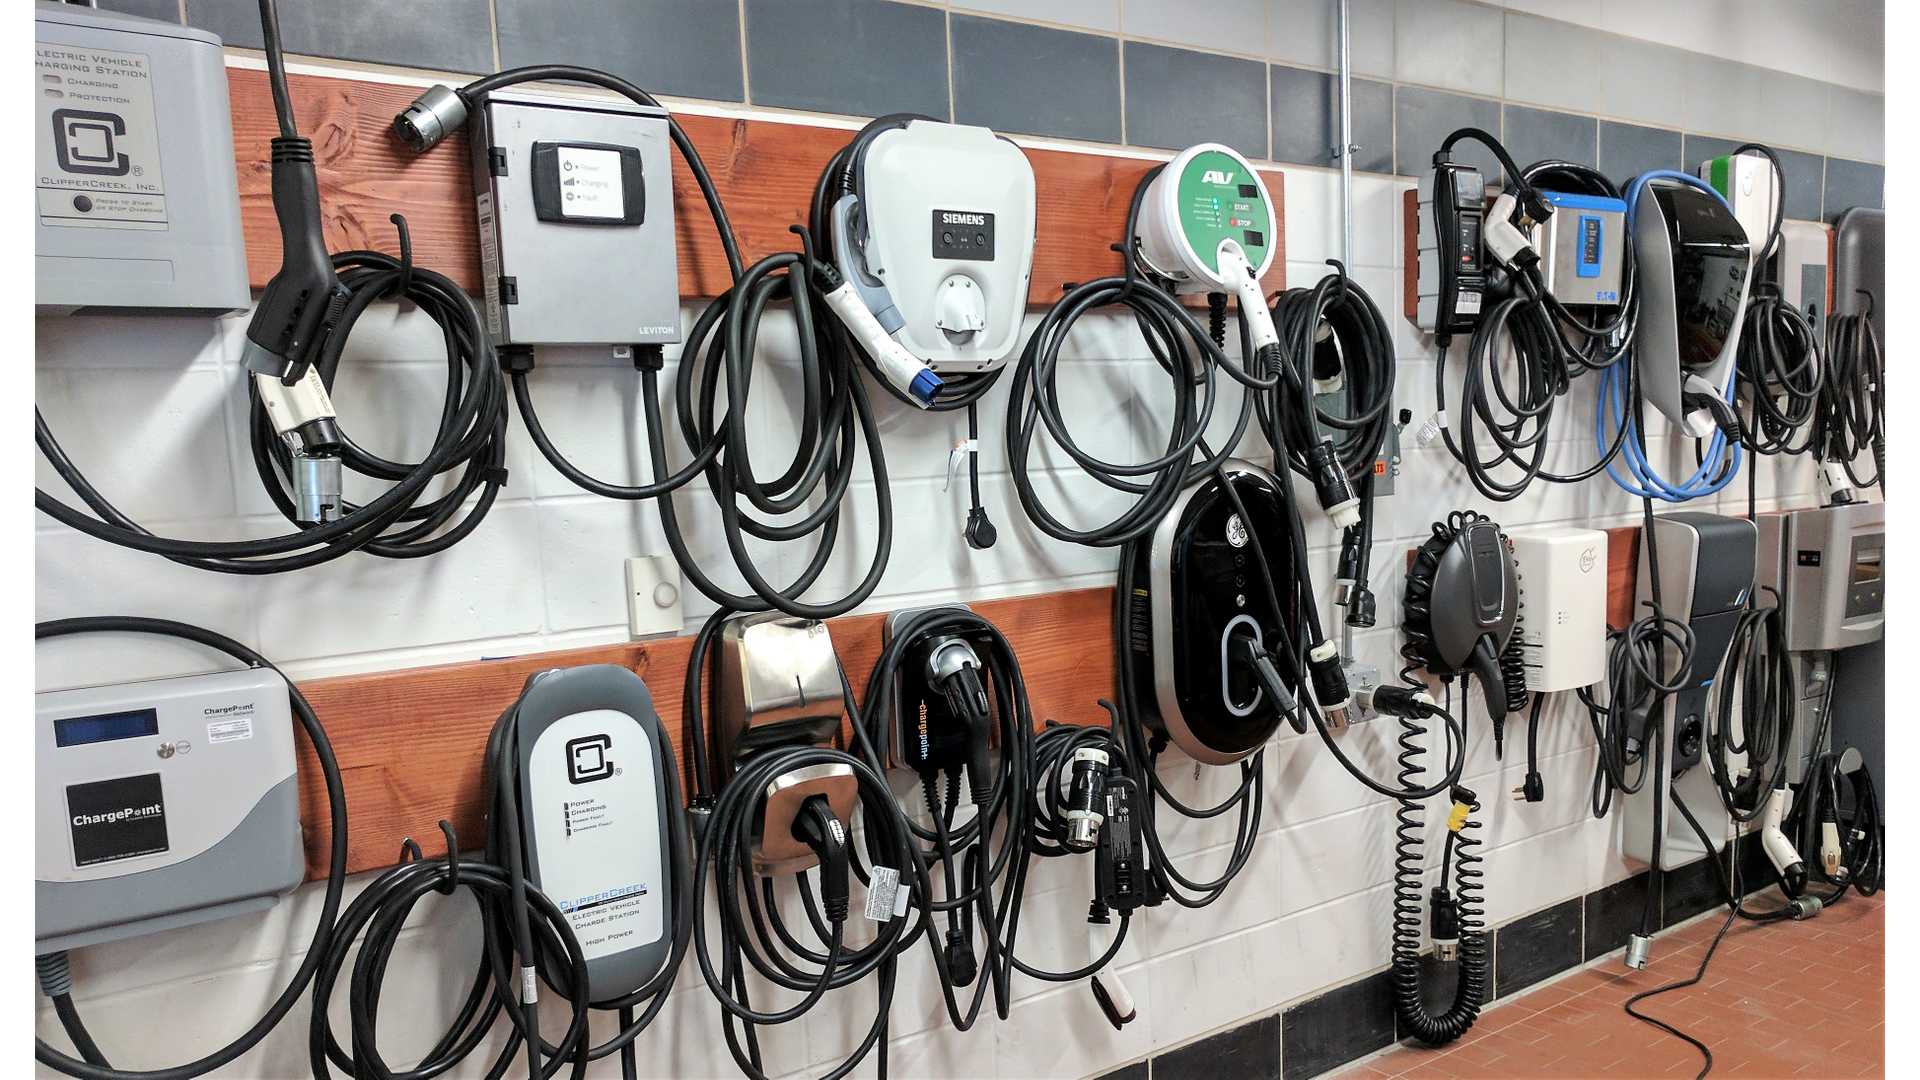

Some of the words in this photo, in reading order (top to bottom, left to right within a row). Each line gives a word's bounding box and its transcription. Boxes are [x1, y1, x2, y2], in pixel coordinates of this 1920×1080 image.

[36, 50, 87, 61] LECTRIC
[92, 55, 143, 68] VEHICLE
[35, 61, 90, 73] HARGING
[96, 65, 147, 78] STATION
[67, 78, 119, 89] CHARGING
[69, 92, 130, 104] PROTECTION
[1201, 171, 1233, 184] AV
[942, 212, 985, 225] SIEMENS
[639, 326, 674, 335] LEVITON
[204, 703, 254, 714] ChargePoint
[570, 799, 594, 807] POWER
[73, 803, 162, 825] ChargePoint
[571, 804, 607, 816] CHARGING
[573, 908, 607, 920] ELECTRIC
[609, 900, 640, 911] VEHICLE
[576, 918, 606, 930] CHARGE
[609, 910, 640, 921] STATION
[585, 937, 605, 946] HIGH
[608, 930, 633, 940] POWER
